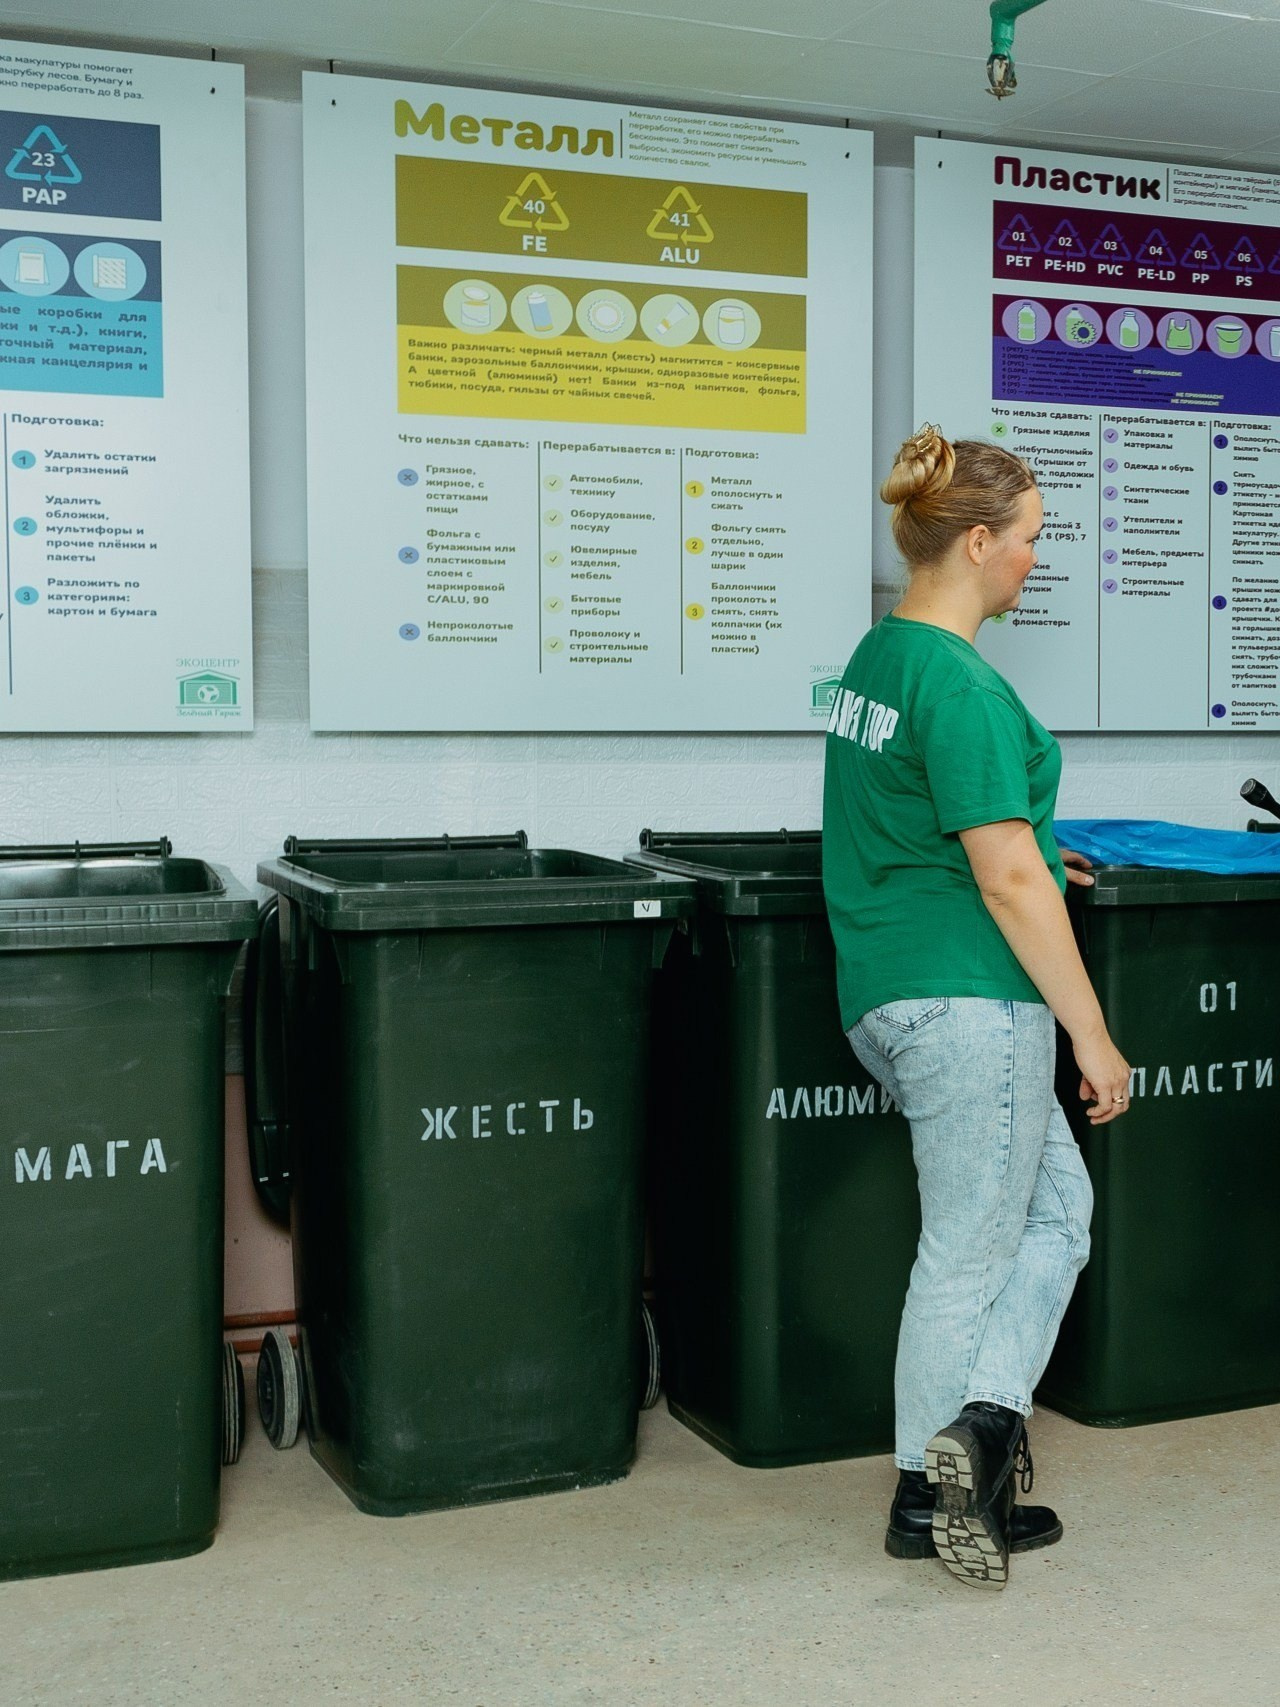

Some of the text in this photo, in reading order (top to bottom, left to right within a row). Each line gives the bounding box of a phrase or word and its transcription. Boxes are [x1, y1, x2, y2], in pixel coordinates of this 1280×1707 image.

[14, 56, 133, 74] макулатуры помогает
[84, 73, 124, 87] Бумагу
[20, 81, 144, 100] переработать до 8 раз.
[394, 98, 614, 158] Металл
[31, 151, 56, 168] 23
[994, 155, 1161, 201] Пластик
[22, 186, 67, 206] PAP
[522, 199, 691, 227] 40 41
[522, 234, 700, 265] FE ALU
[1011, 231, 1026, 242] 01
[1058, 236, 1073, 247] 02
[1103, 240, 1118, 251] 03
[1148, 245, 1163, 256] 04
[1193, 249, 1208, 260] 05
[1237, 252, 1252, 263] 06
[1005, 254, 1033, 267] PET
[1044, 258, 1086, 273] PE-HD
[1097, 263, 1124, 276] PVC
[1137, 267, 1176, 281] PE-LD
[1191, 272, 1210, 284] PP
[1235, 275, 1253, 287] PS
[37, 307, 147, 323] коробки для
[98, 328, 147, 340] книги,
[68, 342, 148, 356] материал,
[407, 338, 800, 372] Важно различать: черный металл (жесть) магнитится консервные
[41, 357, 133, 372] канцелярия
[11, 413, 104, 427] Подготовка:
[991, 407, 1093, 421] Что нельзя сдавать:
[1103, 413, 1196, 427] Перерабатывается
[1012, 425, 1090, 437] Грязные изделия
[1213, 419, 1272, 431] Подготовка:
[1123, 429, 1166, 439] Упаковка
[397, 433, 529, 449] Что нельзя сдавать:
[1123, 441, 1173, 450] материалы
[542, 440, 676, 456] Перерабатывается в:
[685, 447, 759, 460] Подготовка:
[1013, 446, 1093, 456] «Небутылочный»
[43, 449, 157, 462] Удалить остатки
[44, 465, 129, 476] загрязнений
[425, 464, 476, 476] Грязное,
[1123, 461, 1195, 473] Одежда обувь
[569, 473, 643, 486] Автомобили,
[710, 475, 752, 486] Металл
[1048, 470, 1095, 479] подложки
[569, 488, 616, 499] технику
[1123, 484, 1190, 495] Синтетические
[45, 494, 102, 506] Удалить
[425, 492, 489, 502] остатками
[45, 509, 110, 521] обложки,
[570, 508, 656, 521] Оборудование,
[1123, 515, 1175, 524] Утеплители
[45, 524, 133, 537] мультифоры
[570, 523, 611, 534] посуду
[46, 538, 146, 549] прочие плёнки
[570, 545, 638, 557] Ювелирные
[1121, 547, 1205, 558] Мебель, предметы
[46, 554, 96, 562] пакеты
[1121, 560, 1168, 569] интерьера
[47, 577, 140, 589] Разложить по
[711, 581, 776, 592] Баллончики
[1121, 577, 1185, 587] Строительные
[47, 593, 130, 604] категориям:
[570, 594, 622, 604] Бытовые
[47, 606, 158, 618] картон бумага
[570, 607, 621, 618] приборы
[427, 620, 514, 632] Непроколотые
[1011, 617, 1071, 628] фломастеры
[427, 633, 498, 643] баллончики
[711, 644, 760, 656] пластик)
[569, 656, 633, 665] материалы
[1199, 981, 1237, 1013] 01
[420, 1098, 595, 1141] ЖЕСТЬ
[14, 1137, 167, 1183] МАГА
